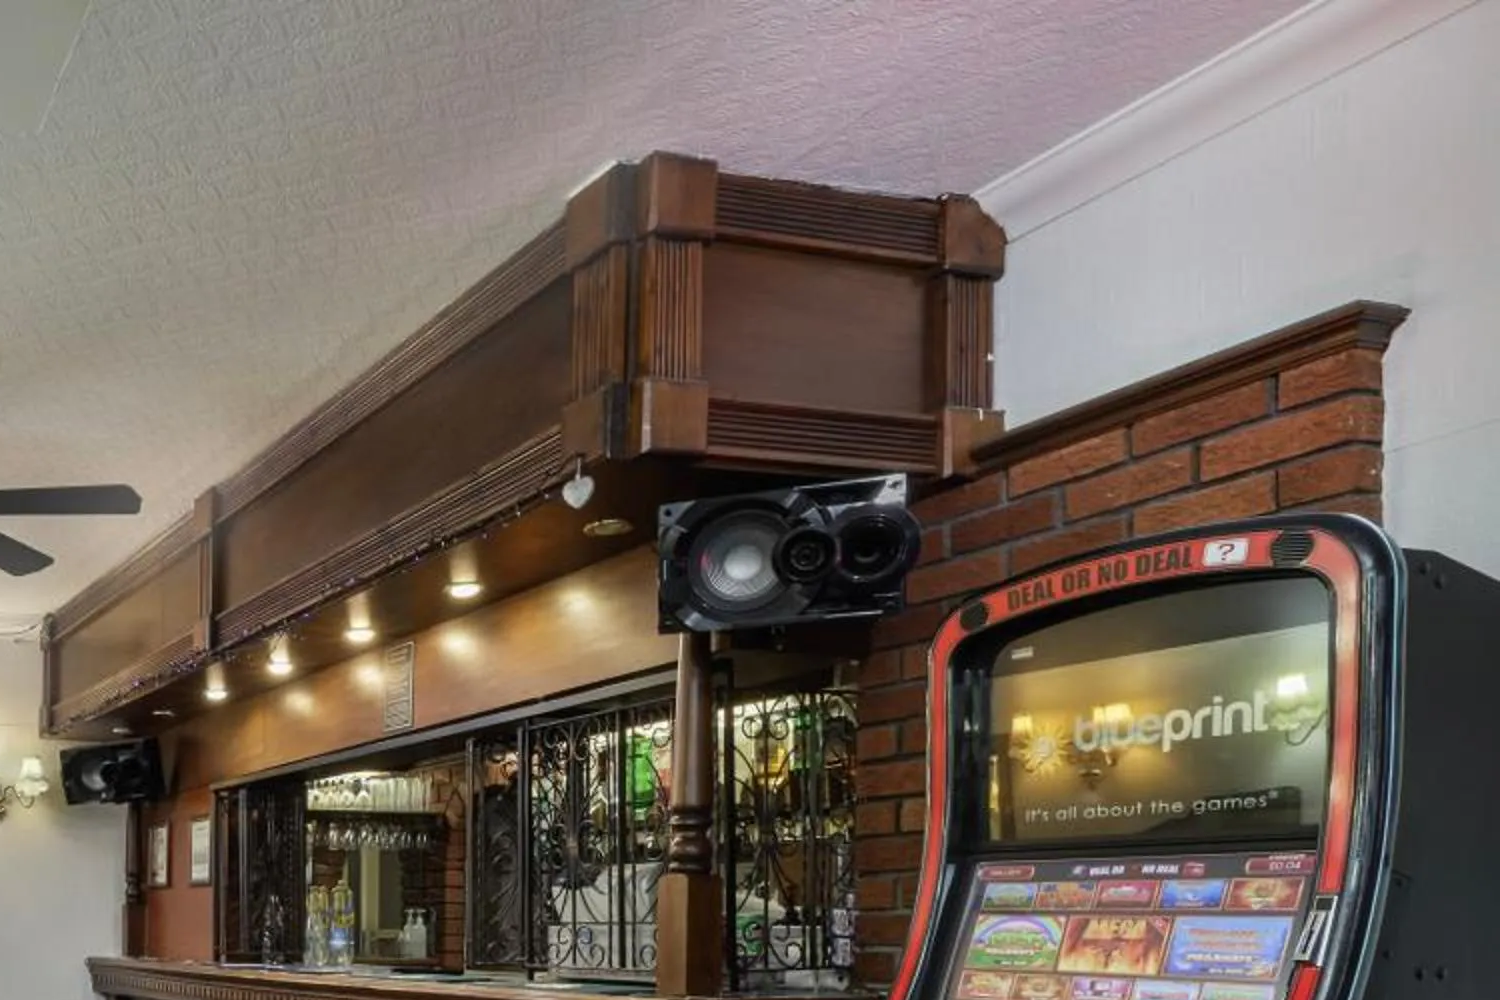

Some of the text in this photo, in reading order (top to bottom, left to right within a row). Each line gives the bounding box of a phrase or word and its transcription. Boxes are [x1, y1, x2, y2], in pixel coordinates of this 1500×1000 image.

[1007, 583, 1056, 611] DEAL
[1061, 568, 1091, 593] OR
[1097, 558, 1128, 585] NO
[1135, 545, 1193, 577] DEAL
[1074, 690, 1269, 753] blueprint
[1025, 807, 1049, 823] It's
[1056, 805, 1077, 821] all
[1083, 802, 1143, 820] about
[1150, 800, 1184, 815] the
